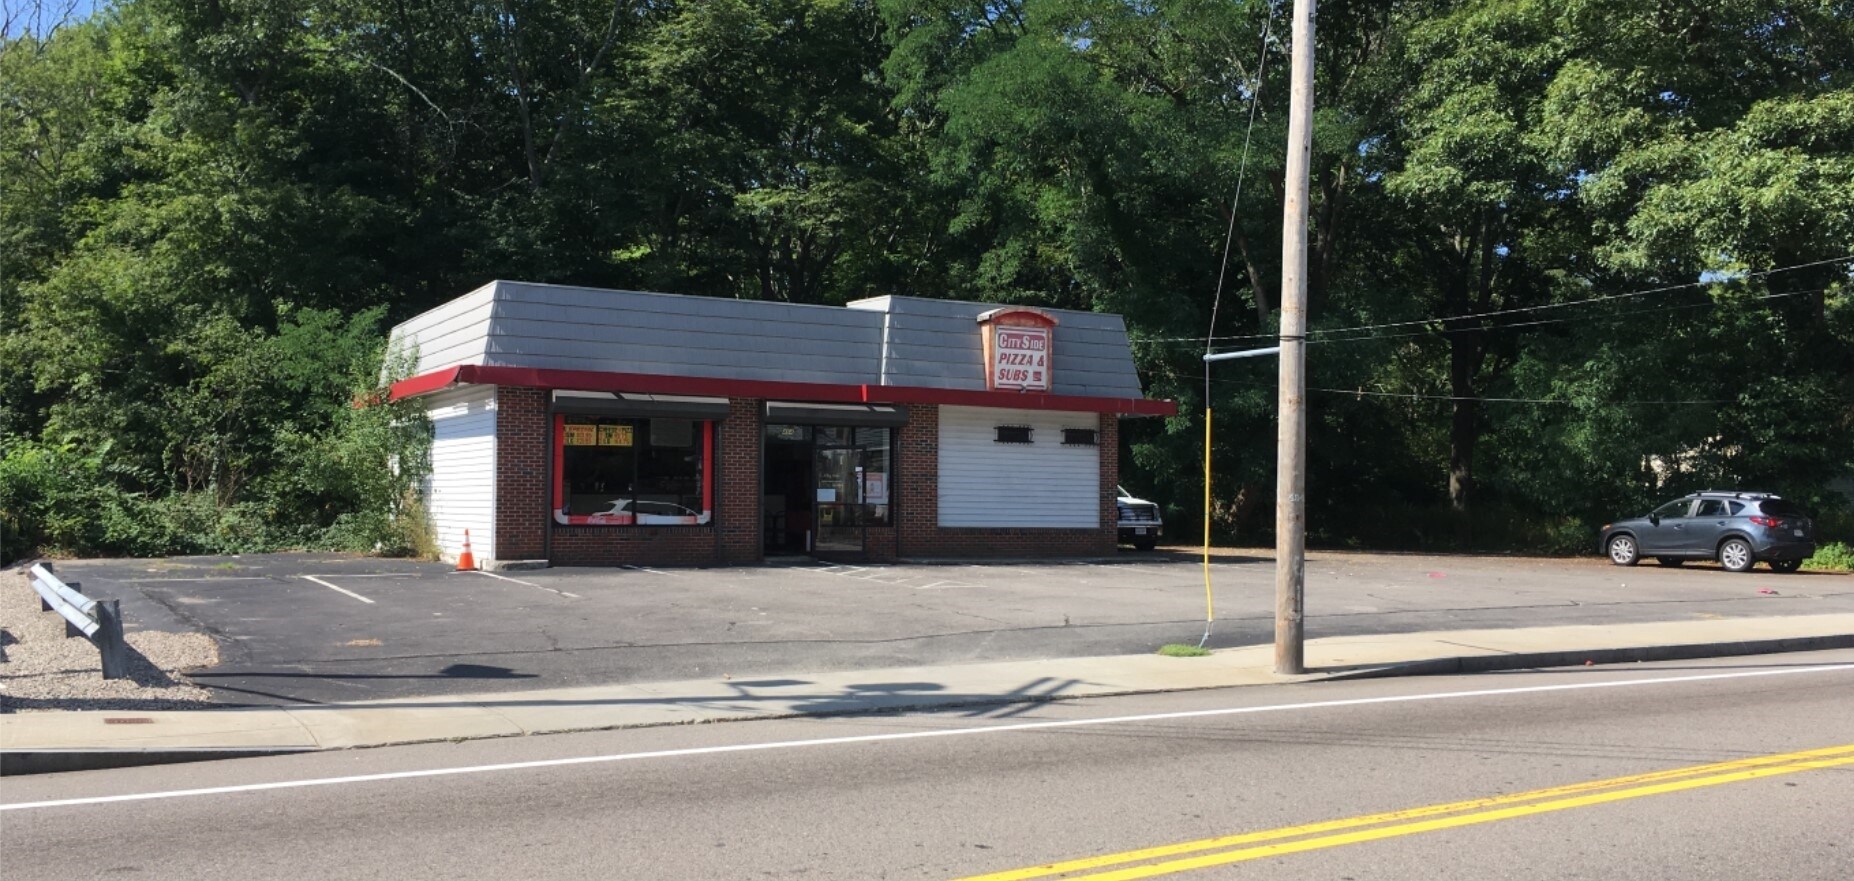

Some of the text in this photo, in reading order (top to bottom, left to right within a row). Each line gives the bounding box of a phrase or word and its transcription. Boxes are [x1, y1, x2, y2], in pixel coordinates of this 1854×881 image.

[999, 352, 1045, 367] PIZZA &
[998, 368, 1029, 382] SUBS
